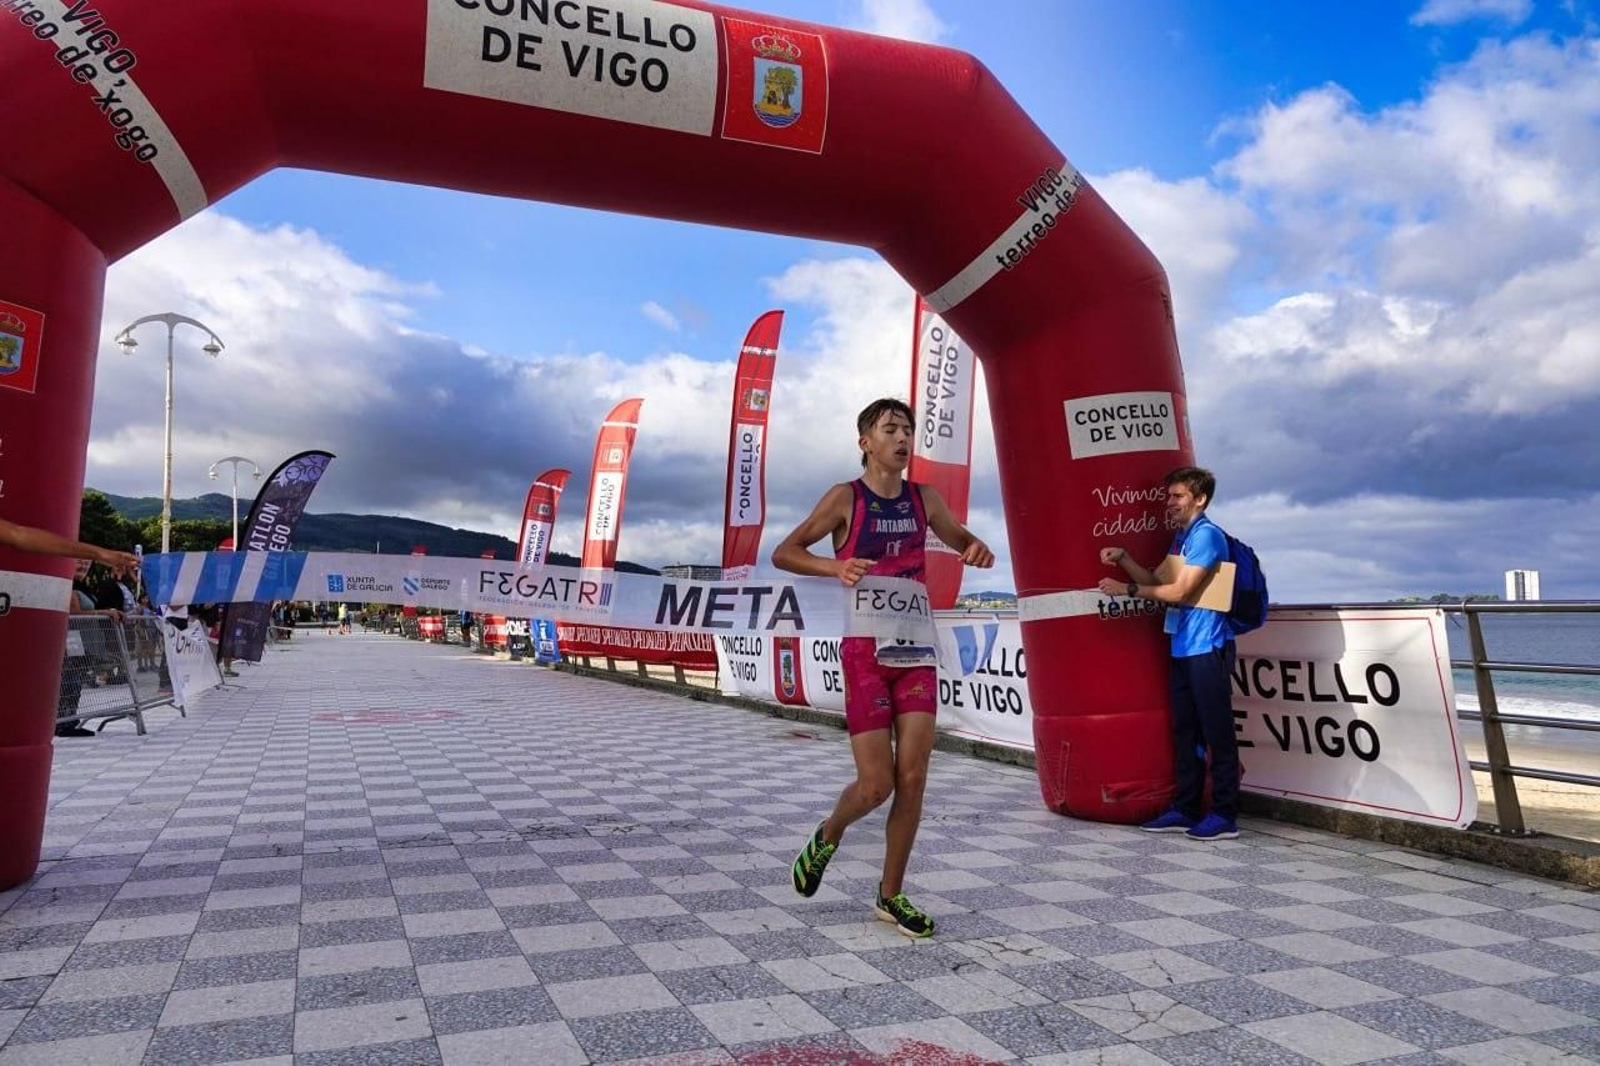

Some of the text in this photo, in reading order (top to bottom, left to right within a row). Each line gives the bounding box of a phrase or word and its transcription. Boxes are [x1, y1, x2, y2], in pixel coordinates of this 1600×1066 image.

[481, 25, 669, 93] DE VIGO
[56, 45, 97, 83] de
[94, 90, 158, 162] xogo
[996, 211, 1056, 271] terreo
[924, 326, 944, 449] CONCELLO
[938, 346, 959, 439] DE VIGO
[1074, 403, 1169, 426] CONCELLO
[1090, 422, 1163, 443] DE VIGO
[1092, 485, 1167, 508] Vivimos
[249, 502, 281, 552] ATLON
[1093, 511, 1157, 537] cidade
[346, 576, 376, 584] XUNTA
[655, 583, 805, 631] META
[719, 635, 762, 657] ONCELLO
[736, 661, 757, 682] VIGO
[822, 669, 843, 693] DE
[939, 679, 1023, 715] DE VIGO
[1262, 713, 1381, 762] VIGO
